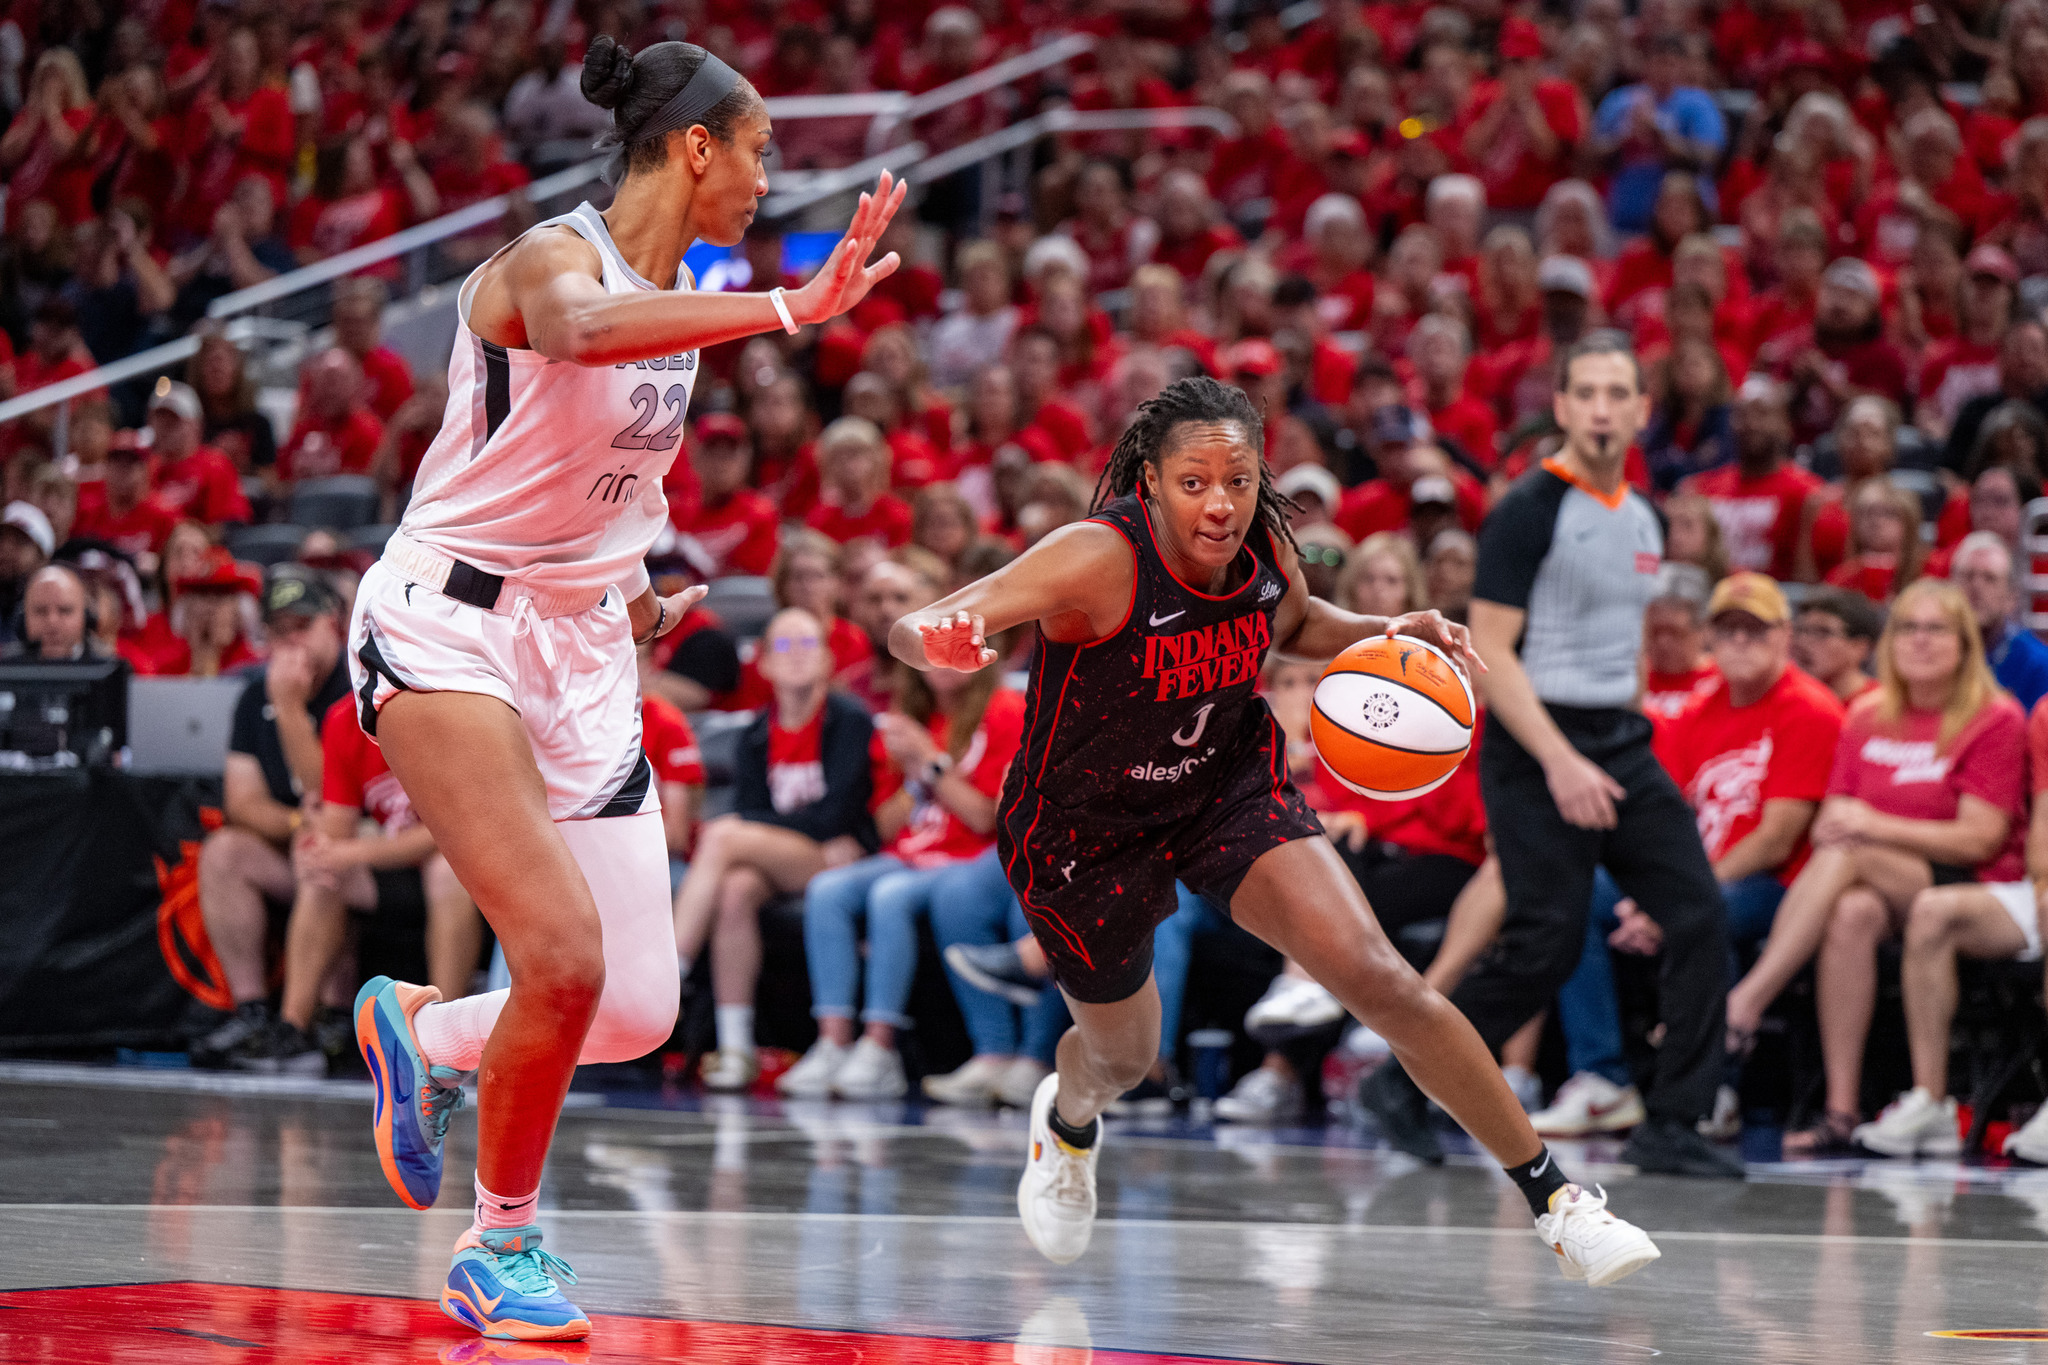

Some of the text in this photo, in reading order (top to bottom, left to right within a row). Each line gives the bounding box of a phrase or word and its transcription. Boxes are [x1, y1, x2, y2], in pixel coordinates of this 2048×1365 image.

[610, 383, 687, 451] 22
[586, 464, 639, 504] rin
[1257, 580, 1282, 603] Lilly
[1141, 609, 1271, 679] INDIANA
[1154, 647, 1260, 702] FEVER
